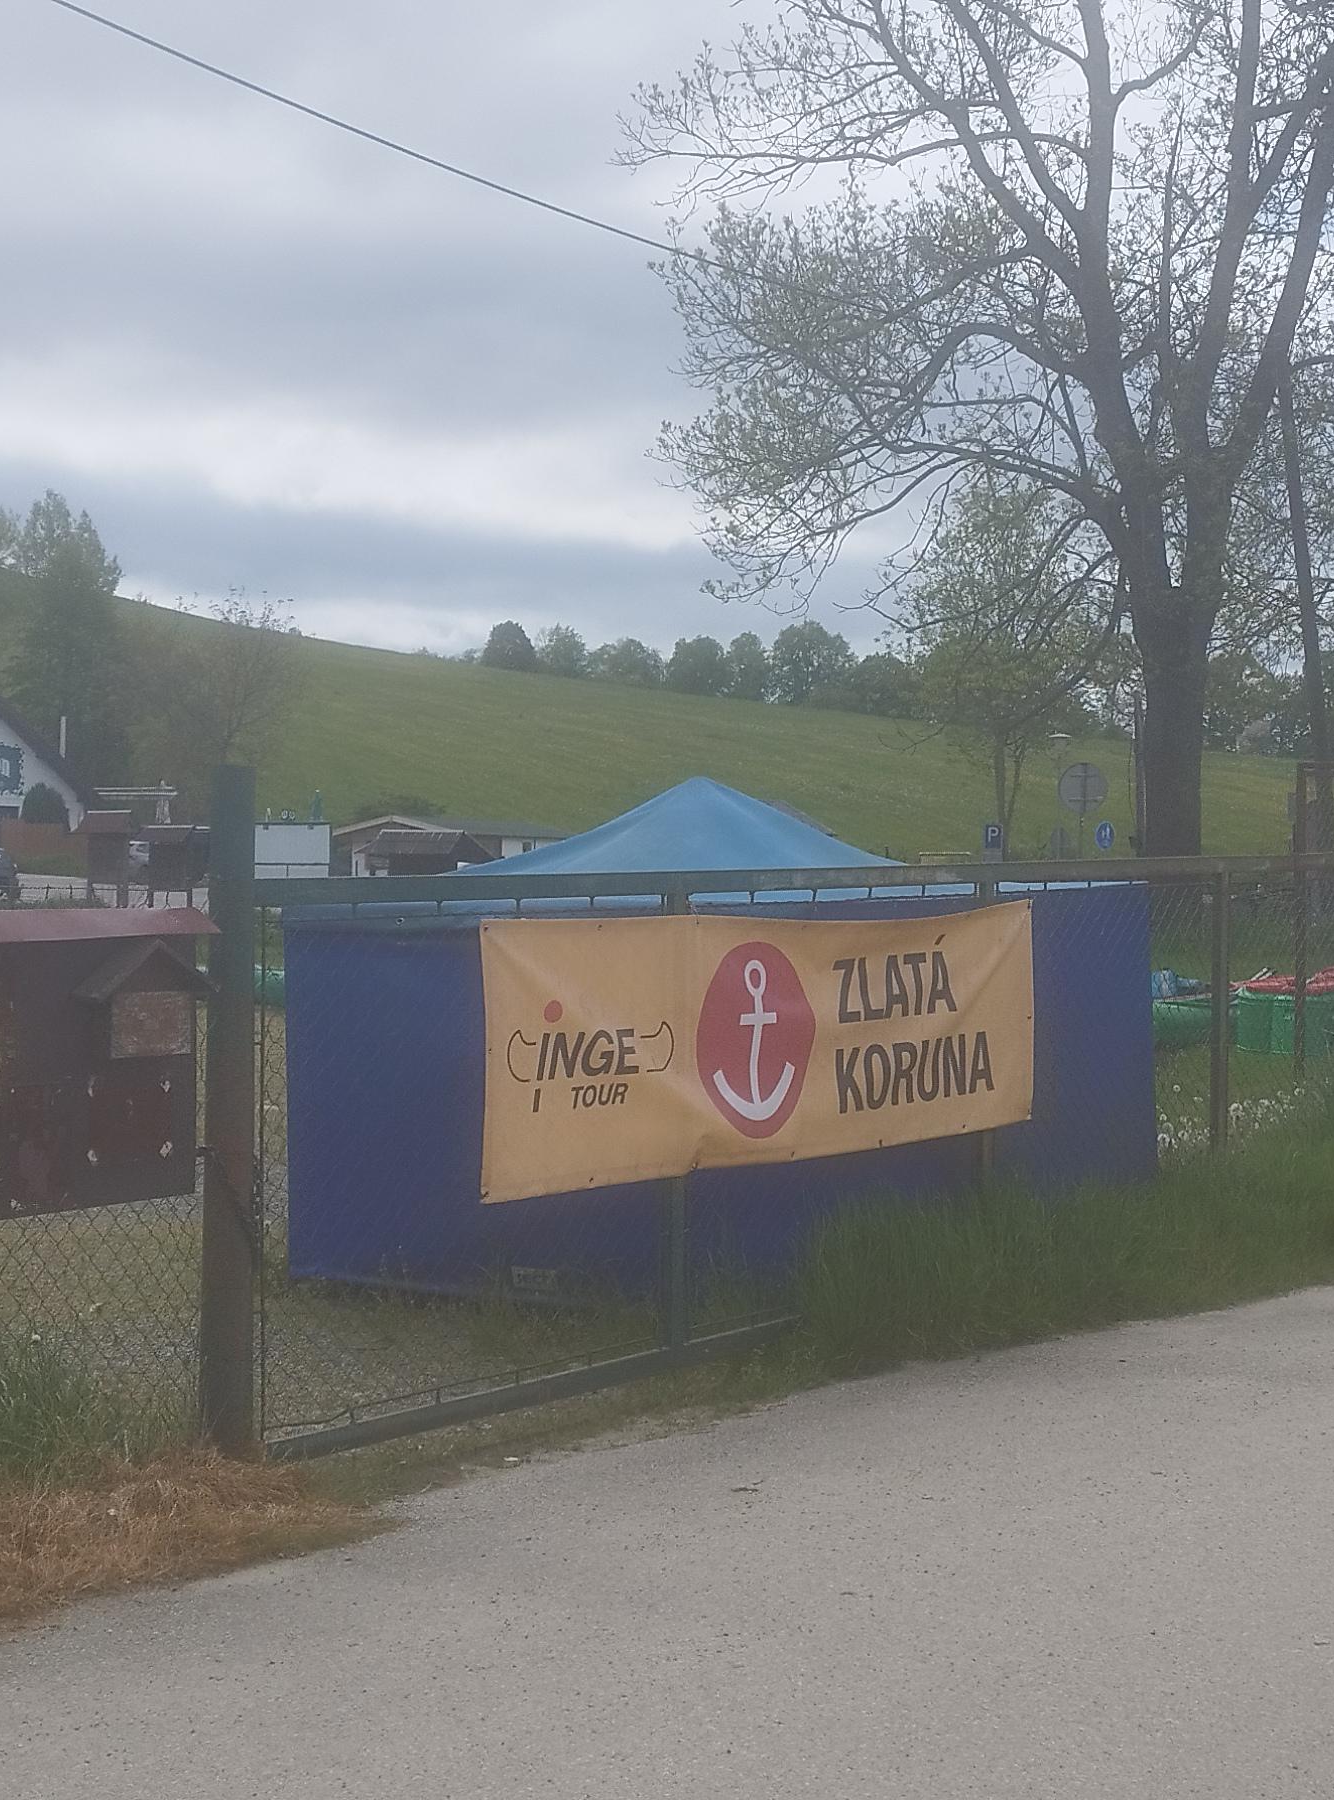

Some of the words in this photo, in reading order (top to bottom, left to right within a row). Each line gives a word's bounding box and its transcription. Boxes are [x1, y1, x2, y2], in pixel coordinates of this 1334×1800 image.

[988, 827, 999, 842] P
[832, 934, 957, 1024] ZLATÁ
[571, 1082, 629, 1111] TOUR
[835, 1031, 995, 1114] KORUNA
